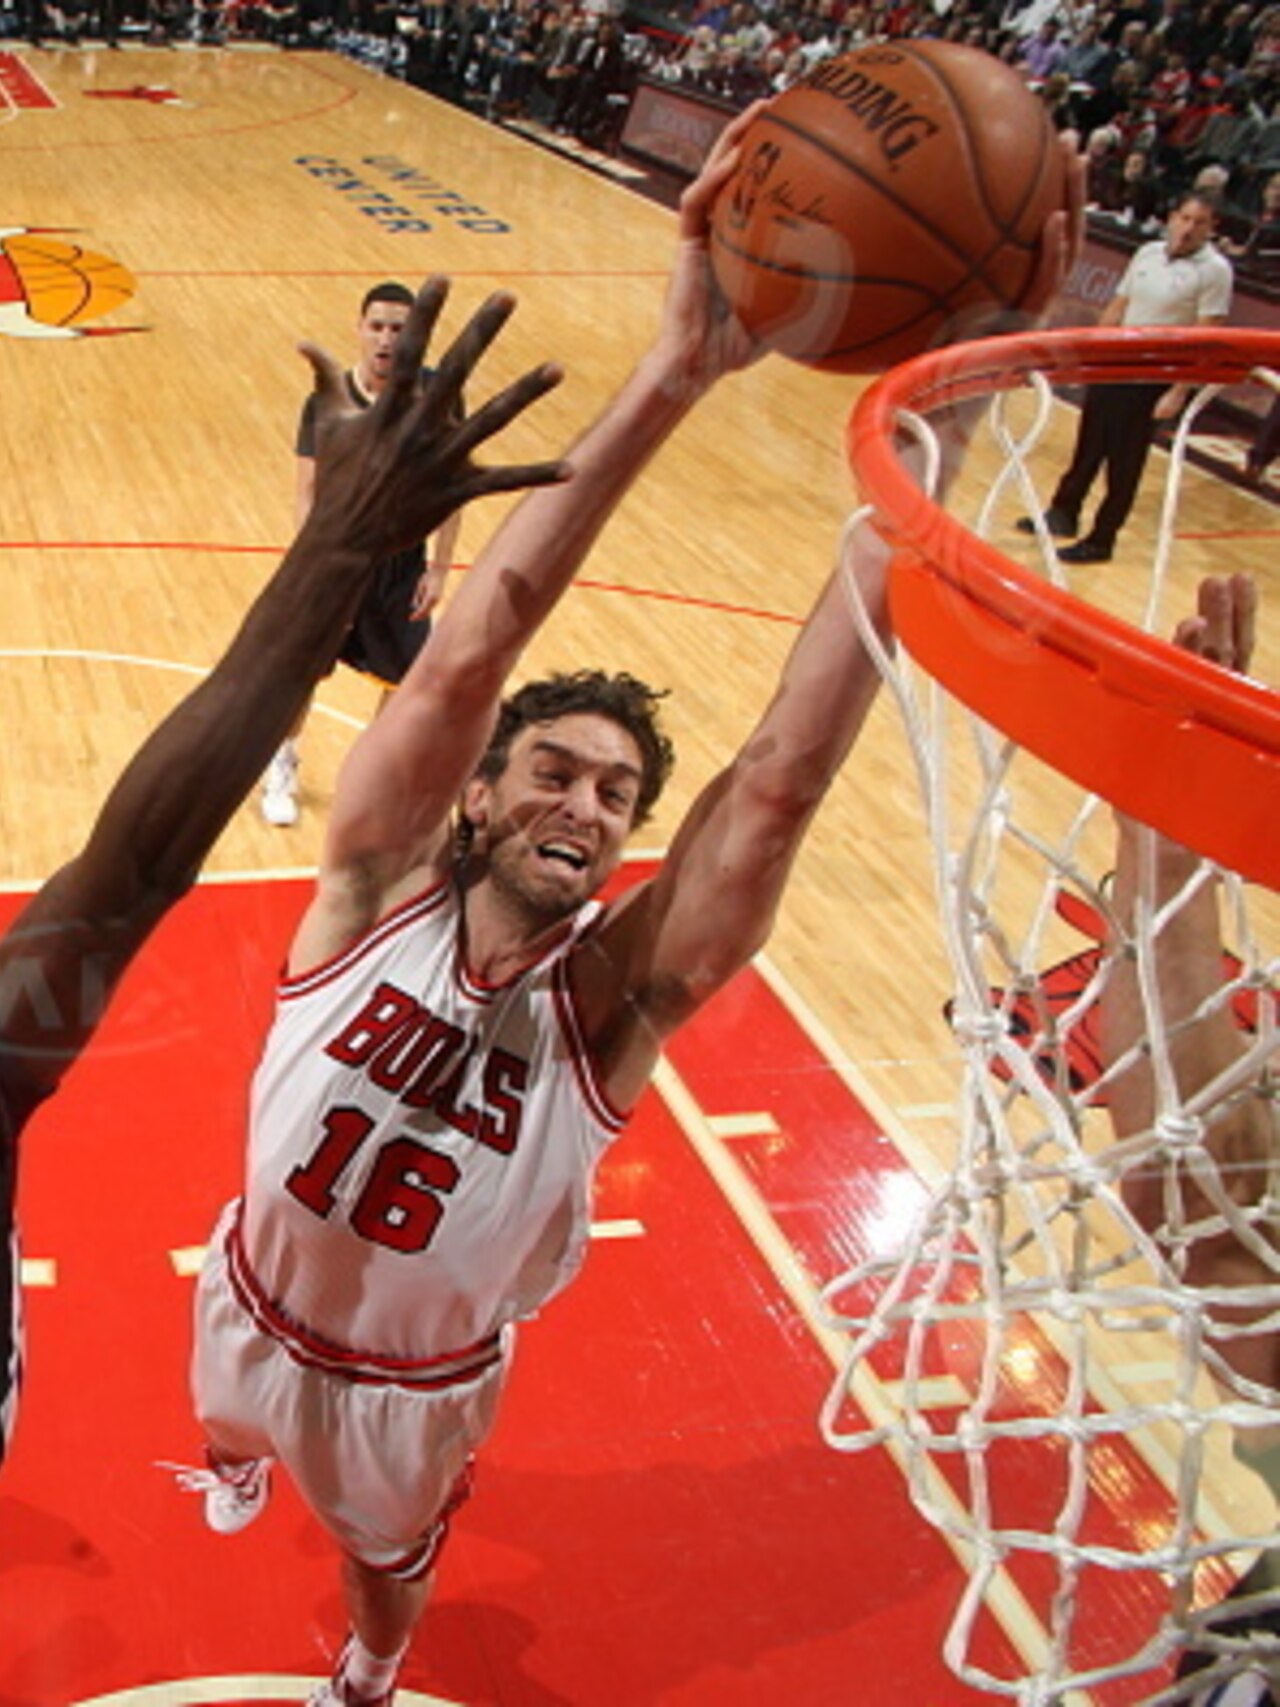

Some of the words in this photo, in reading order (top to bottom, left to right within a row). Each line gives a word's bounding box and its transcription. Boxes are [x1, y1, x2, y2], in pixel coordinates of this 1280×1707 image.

[293, 154, 433, 234] CENTER
[362, 154, 511, 233] UNITED
[284, 1104, 462, 1254] 16
